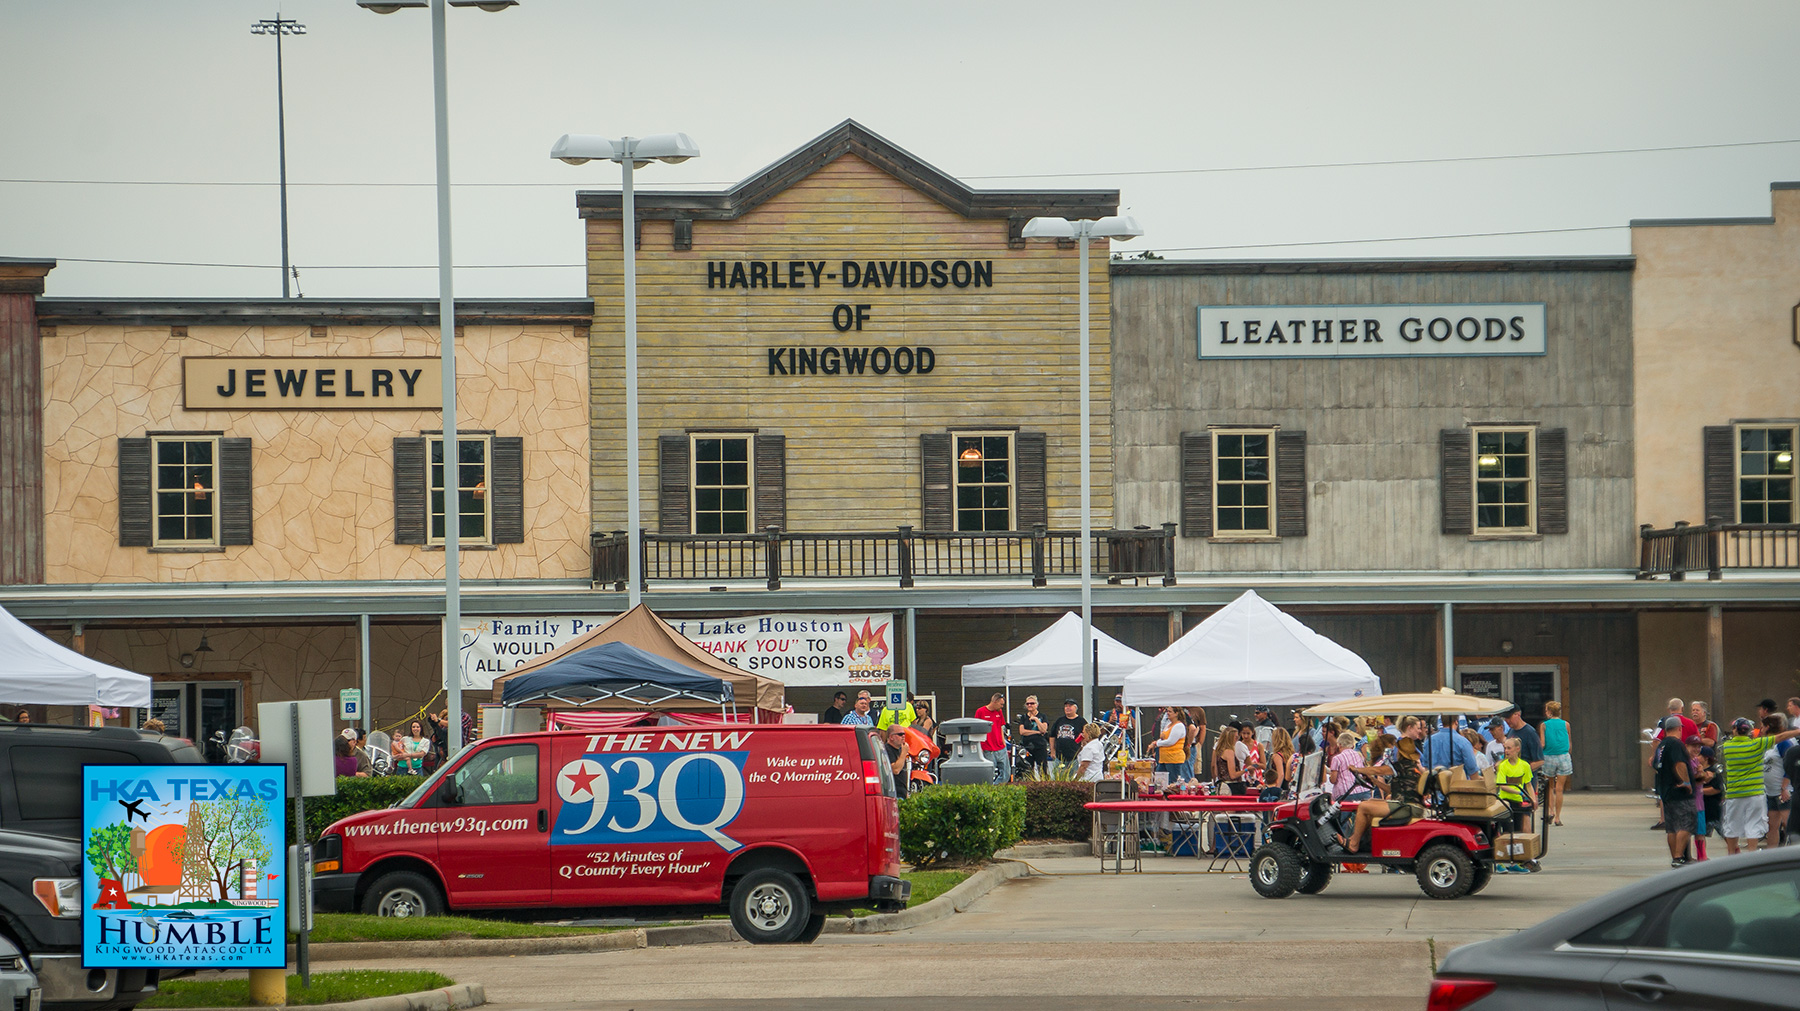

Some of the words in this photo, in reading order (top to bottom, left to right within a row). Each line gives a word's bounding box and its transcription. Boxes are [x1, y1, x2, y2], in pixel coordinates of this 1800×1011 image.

[707, 260, 993, 289] HARLEY-DAVIDSON
[832, 303, 871, 332] OF
[1220, 318, 1383, 345] LEATHER
[1400, 316, 1525, 343] GOODS
[768, 346, 935, 375] KINGWOOD
[216, 369, 422, 397] JEWELRY
[491, 619, 560, 637] Family
[698, 620, 747, 635] Lake
[758, 617, 844, 633] Houston
[493, 641, 555, 655] WOULD
[806, 639, 828, 652] TO
[475, 659, 506, 672] ALL
[748, 655, 845, 669] SPONSORS
[848, 670, 891, 678] HOGS
[584, 733, 655, 752] THE
[659, 731, 754, 750] NEW
[766, 756, 797, 767] Wake
[800, 758, 815, 769] up
[818, 754, 843, 766] with
[748, 772, 767, 783] the
[769, 771, 781, 784] Q
[783, 771, 832, 784] Morning
[834, 770, 860, 781] Zoo.
[556, 753, 744, 852] 93Q
[344, 817, 528, 837] www.thenew93q.com
[612, 851, 665, 863] Minutes
[668, 849, 684, 861] of
[559, 865, 573, 879] Q
[575, 864, 628, 879] Country
[630, 863, 666, 878] Every
